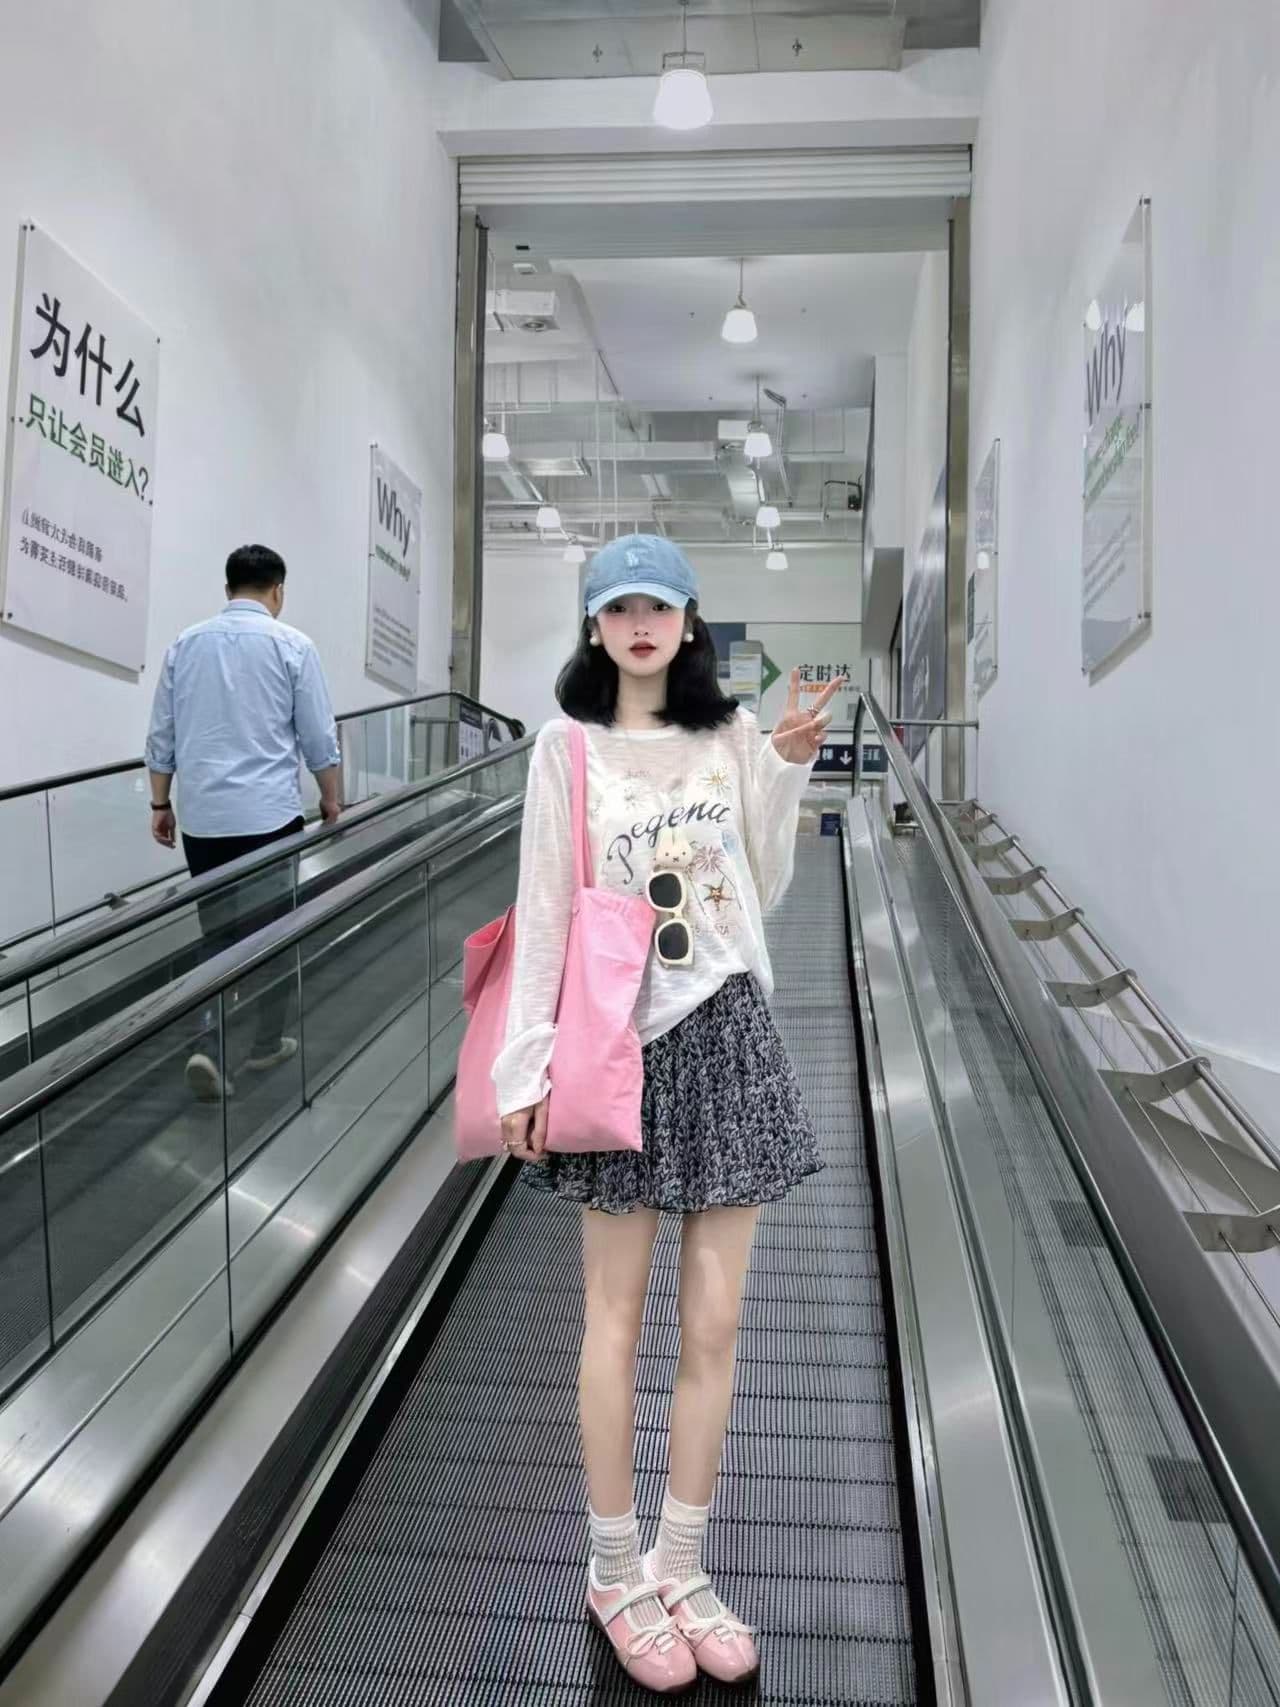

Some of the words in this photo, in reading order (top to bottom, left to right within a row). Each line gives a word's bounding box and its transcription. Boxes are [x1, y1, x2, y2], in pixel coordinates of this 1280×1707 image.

[30, 292, 145, 437] 为什么
[1086, 310, 1127, 426] Why
[377, 477, 411, 558] Why
[799, 663, 852, 683] 定时达
